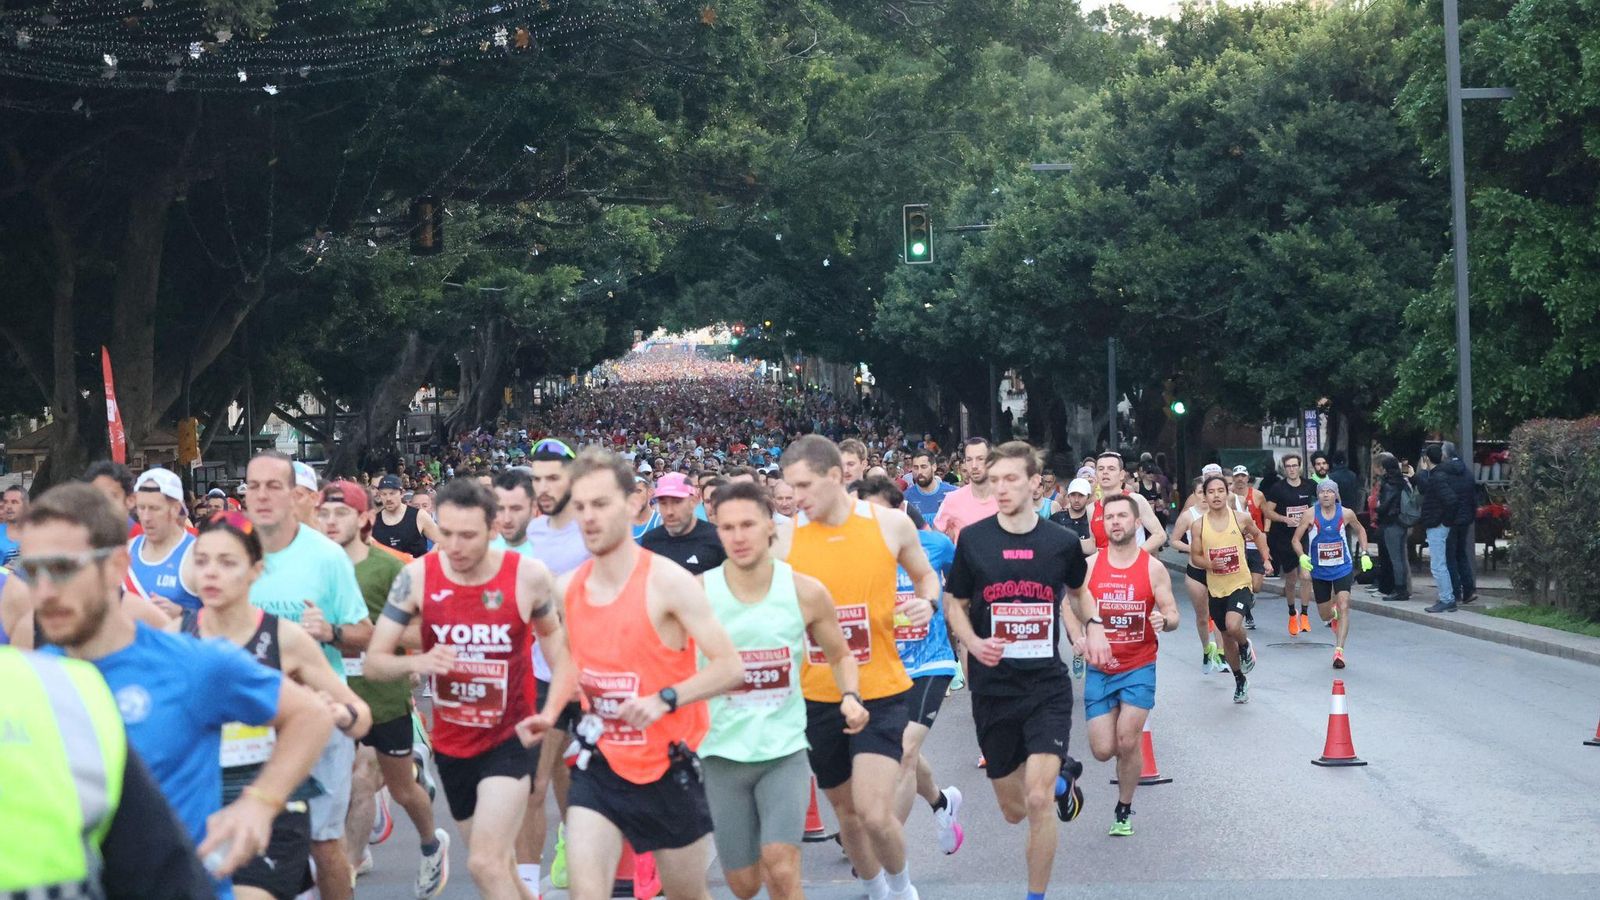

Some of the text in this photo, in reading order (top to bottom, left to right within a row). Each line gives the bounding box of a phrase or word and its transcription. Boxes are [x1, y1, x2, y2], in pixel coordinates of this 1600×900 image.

[984, 581, 1053, 602] CROATIA
[1009, 606, 1047, 615] GENERALI
[1110, 616, 1132, 625] 5351
[431, 624, 512, 643] YORK
[1005, 623, 1040, 634] 13058
[450, 682, 486, 697] 2158
